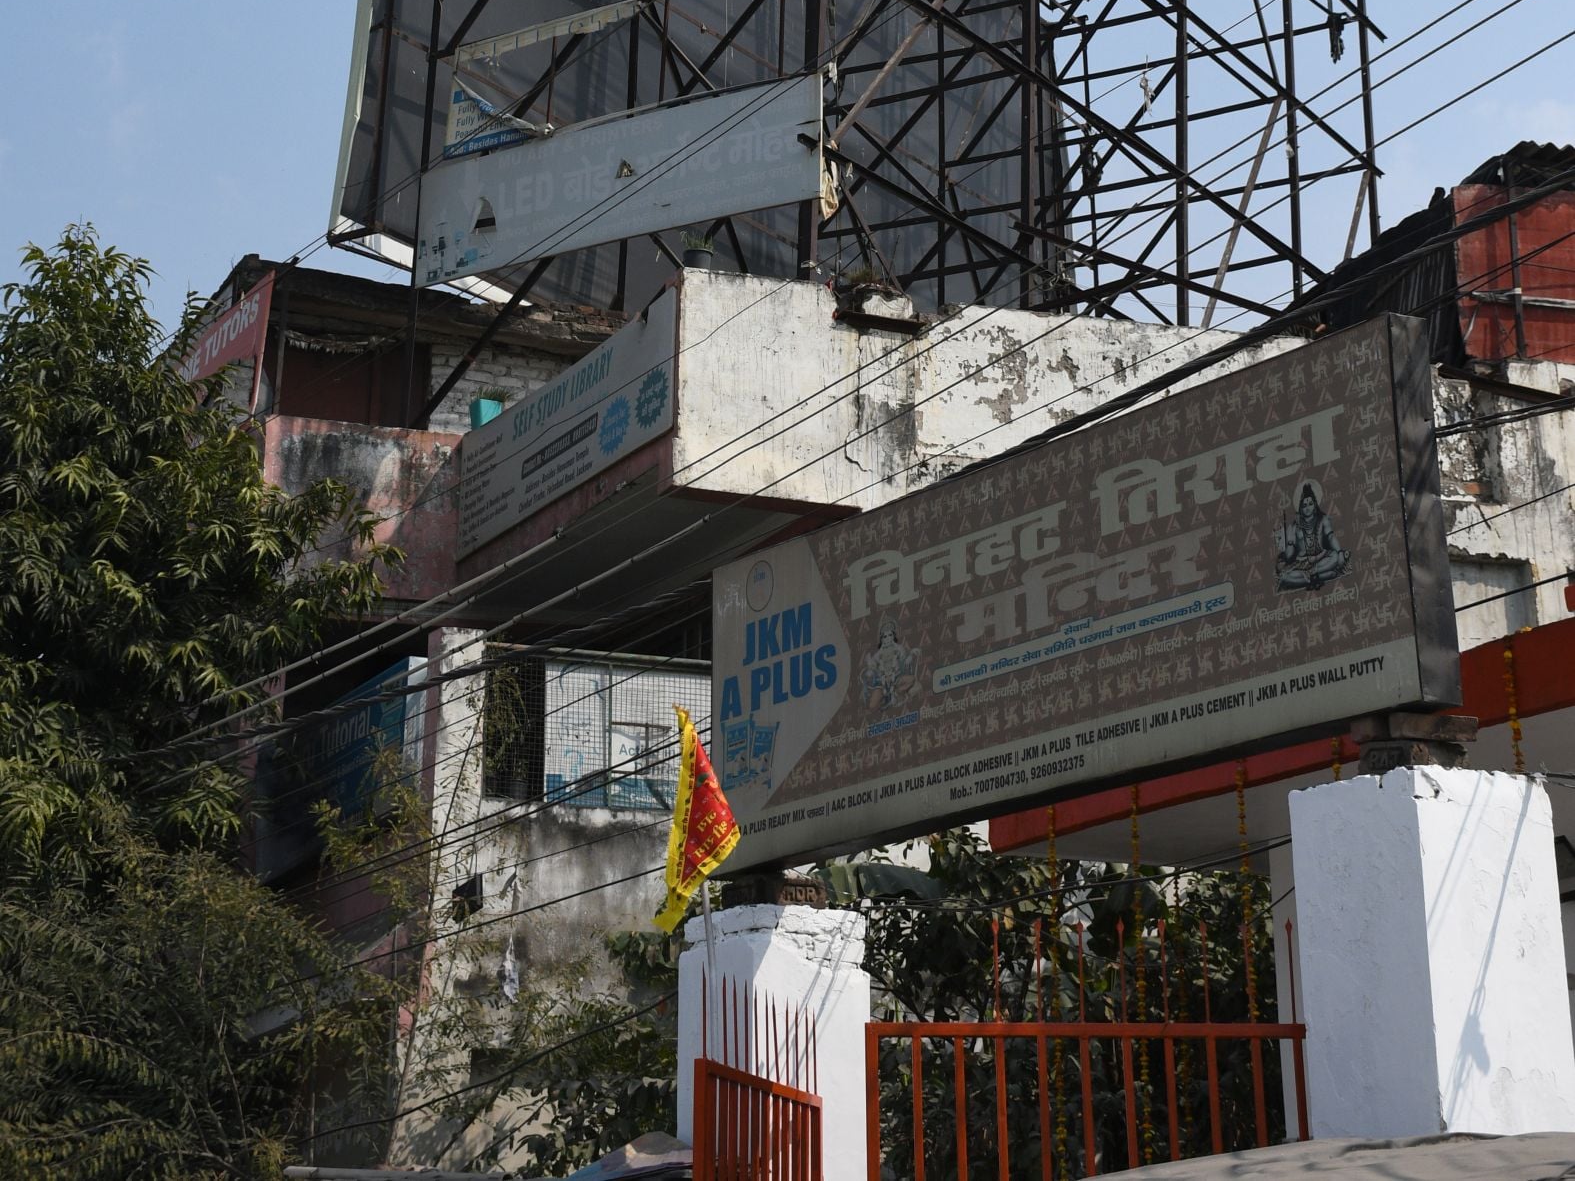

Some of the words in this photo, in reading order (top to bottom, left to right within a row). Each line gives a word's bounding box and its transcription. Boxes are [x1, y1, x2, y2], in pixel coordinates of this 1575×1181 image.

[456, 116, 475, 128] Fully
[468, 138, 498, 152] Besides
[497, 170, 556, 221] LED
[205, 292, 261, 366] TUTORS
[512, 402, 535, 441] SELF
[536, 379, 570, 427] STUDY
[570, 347, 614, 402] LIBRARY
[841, 499, 1067, 621] चिनहट
[1090, 405, 1345, 536] तिराहा
[948, 525, 1213, 646] मन्दिर
[742, 602, 812, 667] JKM
[938, 671, 952, 688] श्री
[954, 664, 988, 684] जानकी
[990, 656, 1020, 675] मन्दिर
[1021, 648, 1043, 667] सेवा
[1044, 639, 1077, 659] समिति
[1116, 622, 1137, 635] जन
[1139, 602, 1202, 630] कल्याणकारी
[720, 675, 743, 721] A
[750, 643, 838, 713] PLUS
[320, 705, 371, 762] Tutorial
[742, 823, 749, 836] A
[749, 819, 768, 835] PLUS
[768, 813, 791, 830] READY
[792, 808, 807, 823] MIX
[831, 797, 846, 812] AAC
[848, 790, 873, 808] BLOCK
[880, 782, 897, 799] JKM
[898, 782, 904, 795] A
[905, 776, 925, 794] PLUS
[926, 773, 942, 790] AAC
[944, 763, 971, 782] BLOCK
[972, 752, 1013, 775] ADHESIVE
[1021, 745, 1039, 762] JKM
[1041, 743, 1048, 757] A
[1049, 736, 1071, 755] PLUS
[1075, 730, 1095, 748] TILE
[1096, 718, 1140, 743] ADHESIVE
[1149, 711, 1169, 729] JKM
[1171, 709, 1178, 724] A
[1180, 702, 1204, 721] PLUS
[1207, 692, 1246, 714] CEMENT
[1256, 683, 1278, 703] JKM
[1280, 682, 1288, 695] A
[1290, 674, 1316, 694] PLUS
[1318, 668, 1347, 686] WALL
[1349, 656, 1385, 679] PUTTY
[950, 784, 974, 801] Mob.:
[974, 774, 1030, 795] 7007804730,
[1030, 754, 1086, 780] 9260932375
